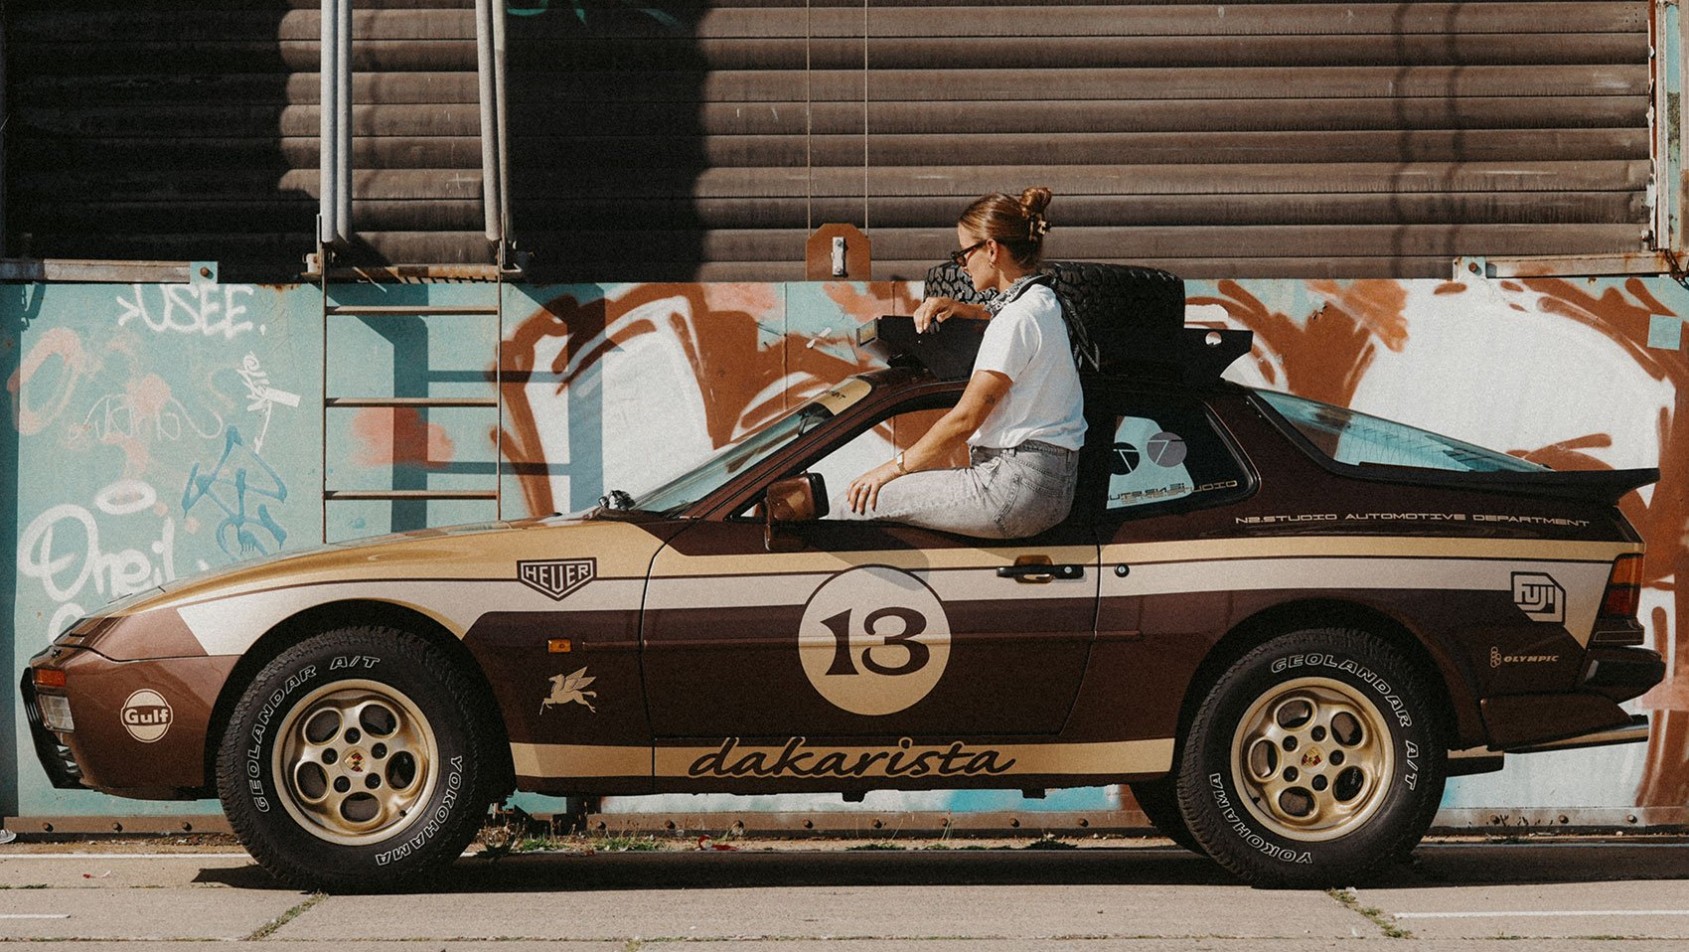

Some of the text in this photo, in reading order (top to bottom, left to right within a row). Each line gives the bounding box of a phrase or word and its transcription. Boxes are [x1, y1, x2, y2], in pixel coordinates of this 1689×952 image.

[1345, 513, 1466, 521] AUTOMOTIVE
[1472, 514, 1590, 527] DEPARTMENT
[525, 564, 589, 593] HEUER
[820, 607, 930, 676] 13
[1503, 655, 1559, 663] OLYMPIC
[124, 708, 168, 724] Gulf
[247, 655, 380, 812] GEOLANDAR A/T
[1271, 653, 1418, 790] GEOLANDAR A/T
[688, 737, 1016, 777] dakarista
[375, 755, 463, 866] YOKOHAMA
[1209, 773, 1313, 864] YOKOHAMA
